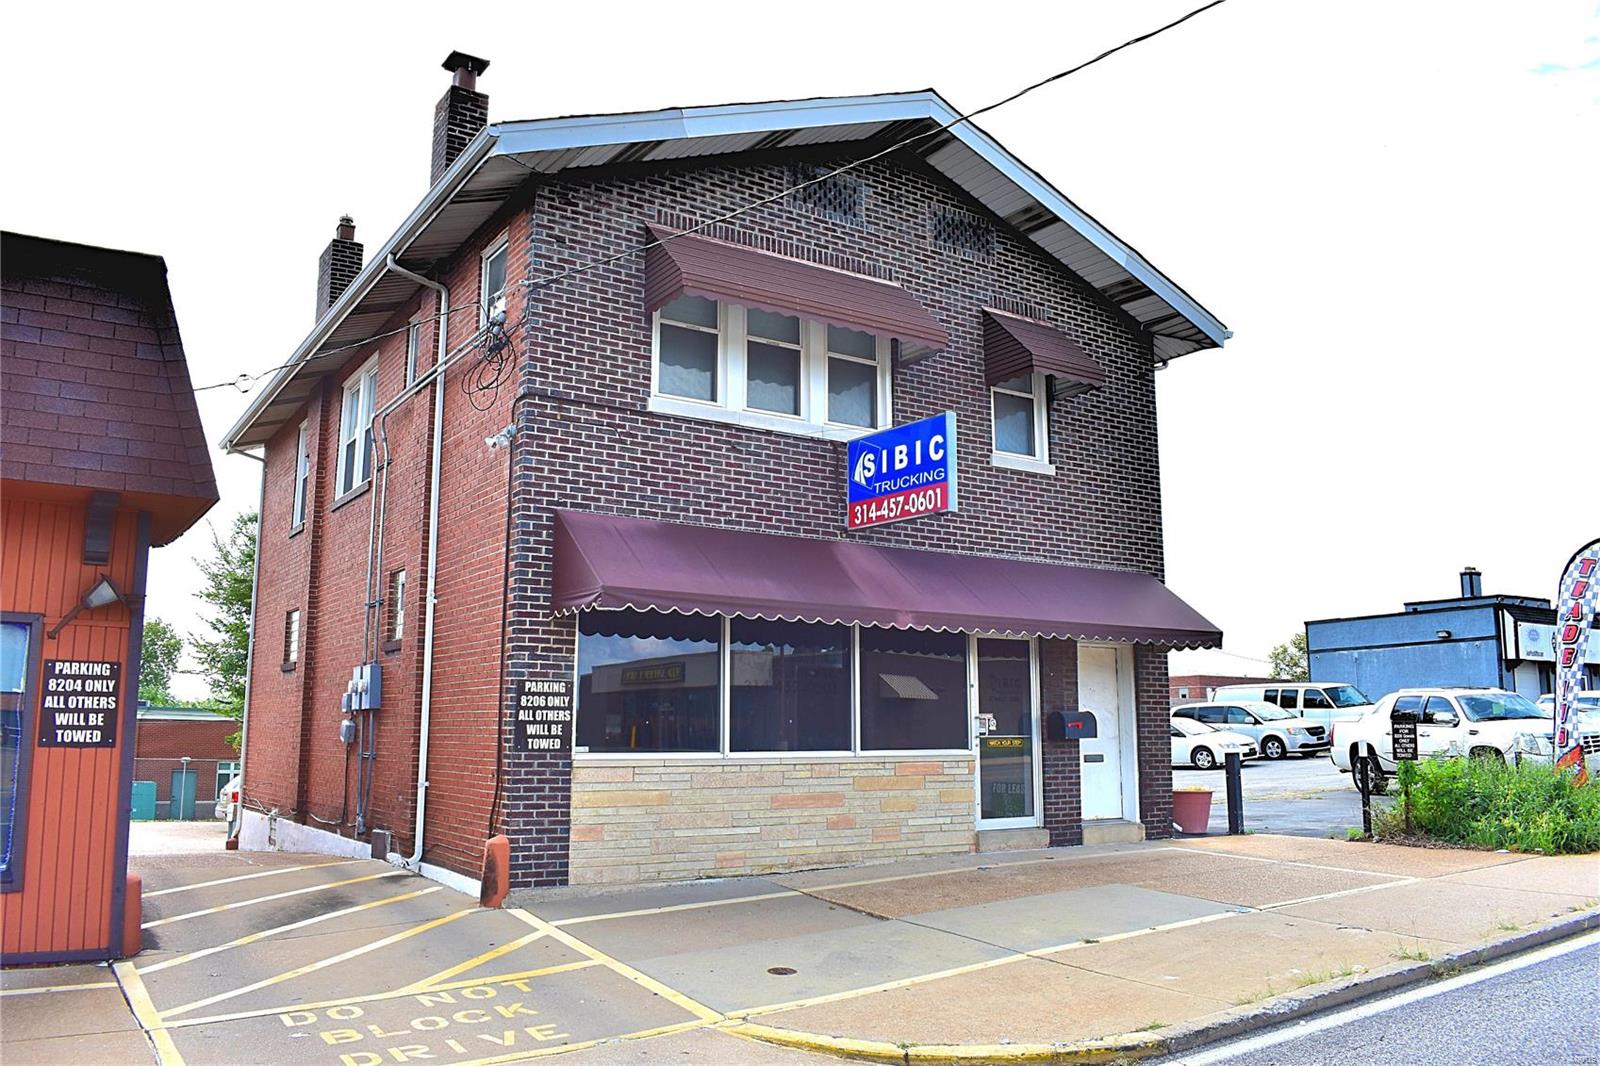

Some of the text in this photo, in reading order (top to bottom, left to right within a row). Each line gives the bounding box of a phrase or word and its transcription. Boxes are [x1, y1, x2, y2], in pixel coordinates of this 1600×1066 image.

[863, 434, 945, 478] SIBIC
[874, 467, 945, 494] TRUCKING
[854, 487, 941, 525] 314-457-0601
[54, 662, 111, 676] PARKING
[48, 678, 116, 692] 8204 ONLY
[524, 681, 566, 693] PARKING
[44, 695, 117, 709] ALL OTHERS
[520, 695, 570, 707] 8206 ONLY
[54, 712, 105, 726] WILL BE
[518, 709, 571, 721] ALL OTHERS
[55, 729, 102, 743] TOWED
[526, 723, 563, 735] WILL BE
[527, 738, 561, 750] TOWED
[278, 979, 533, 1027] DO NOT
[319, 1002, 539, 1046] BLOCK
[338, 1023, 571, 1066] DRIVE
